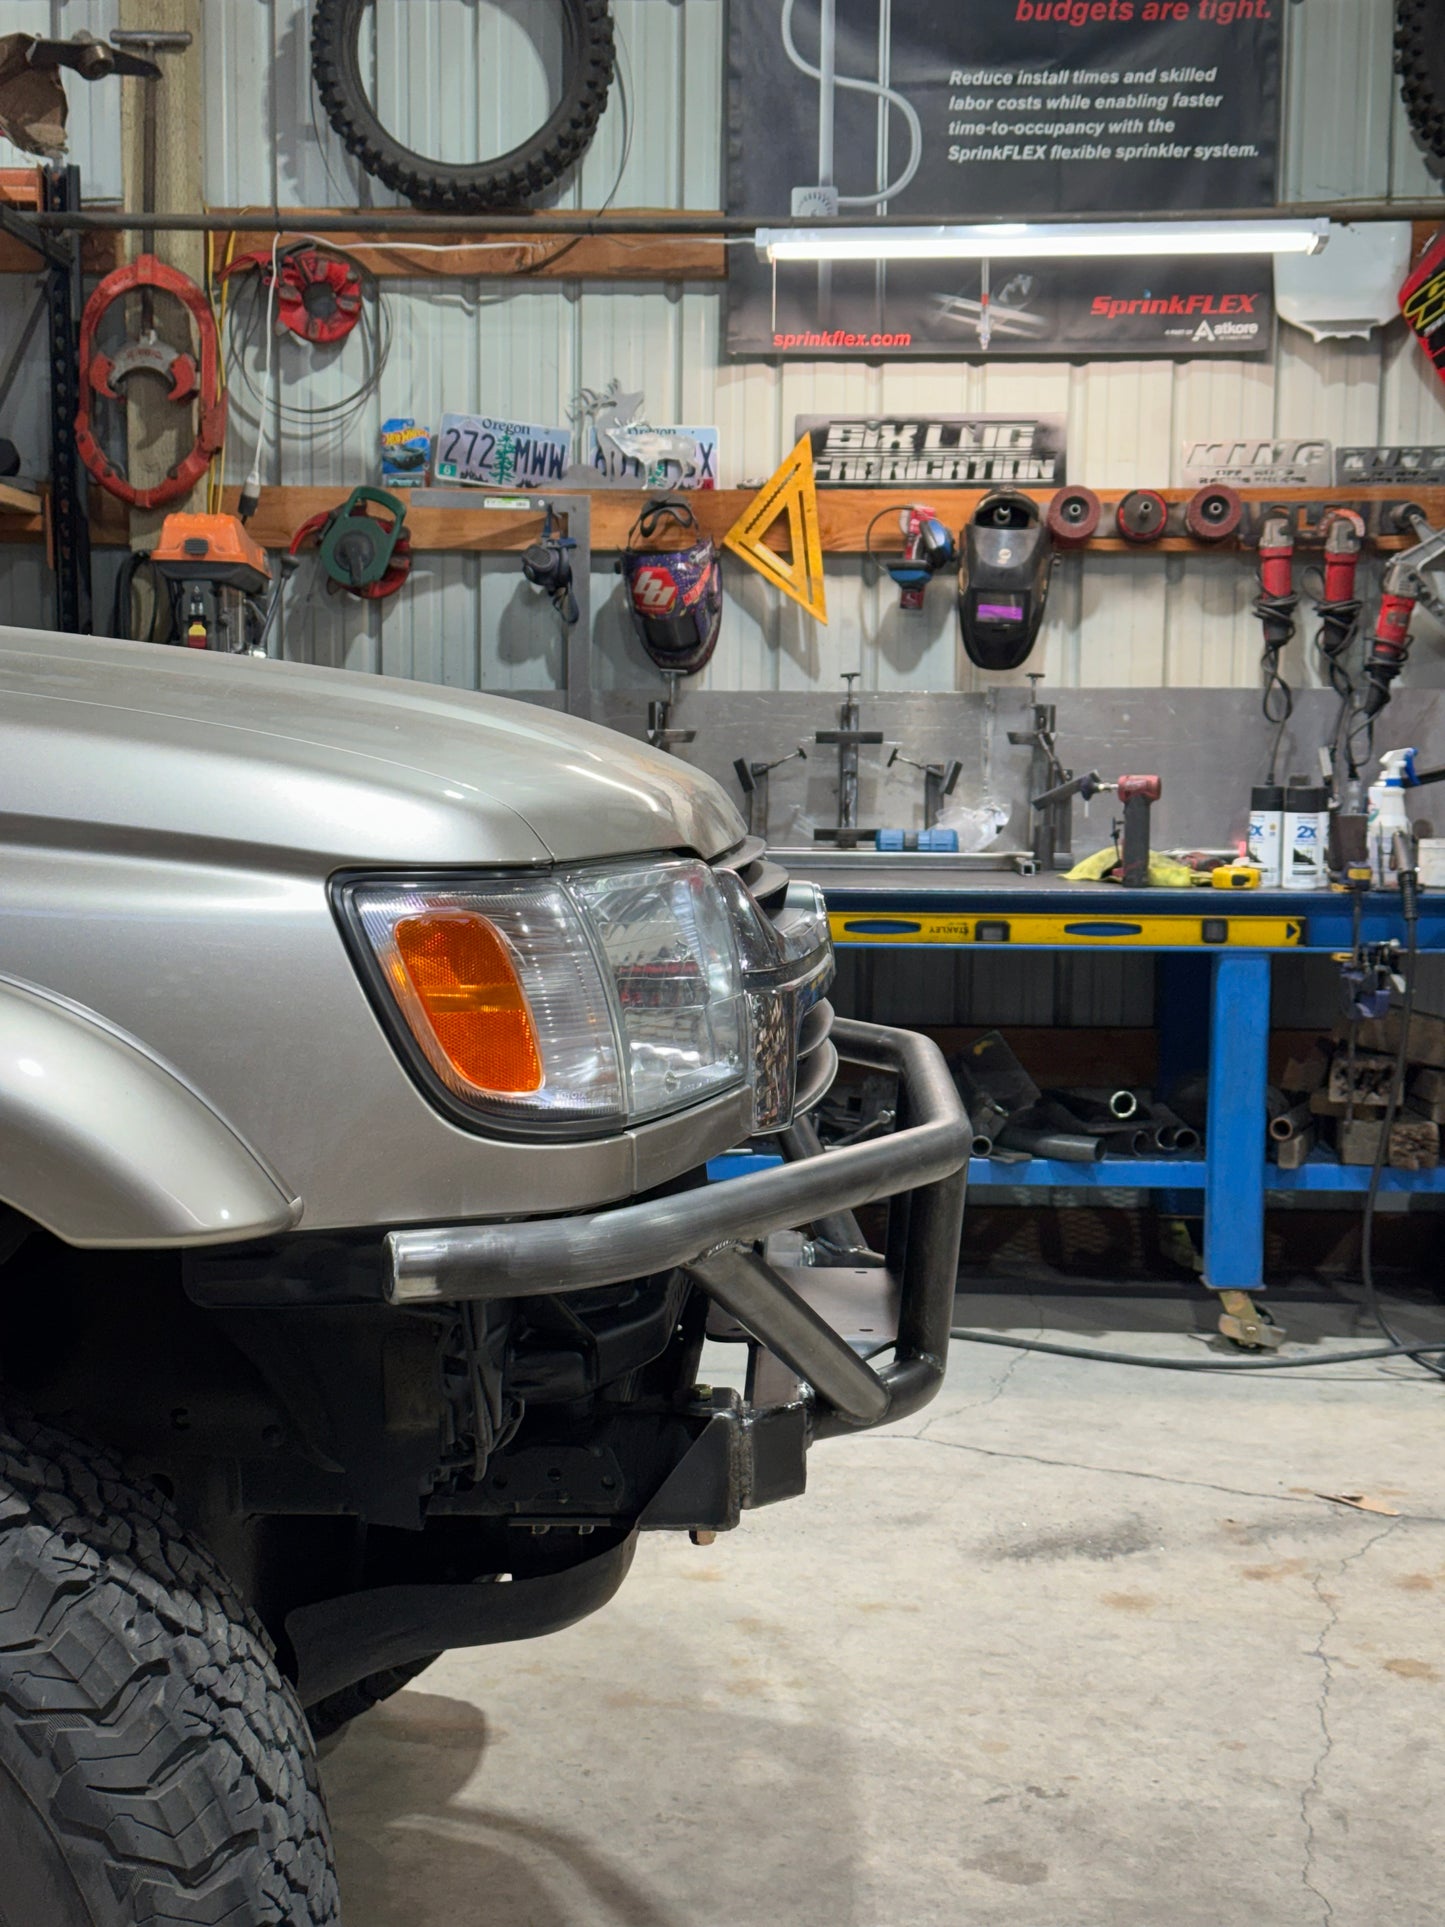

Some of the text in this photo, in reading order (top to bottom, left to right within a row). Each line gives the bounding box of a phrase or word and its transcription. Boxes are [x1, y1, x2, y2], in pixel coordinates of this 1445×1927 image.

[1015, 0, 1272, 27] budgets are tight.
[949, 66, 1218, 86] Reduce install times and skilled
[949, 91, 1223, 111] labor costs while enabling faster
[948, 117, 1176, 138] time-to-occupancy with the
[948, 142, 1259, 163] SprinkFLEX flexible sprinkler system.
[1090, 293, 1259, 319] SprinkFLEX
[1213, 322, 1259, 335] atkore
[773, 330, 912, 350] sprinkflex.com
[481, 417, 531, 436] Oregon
[443, 427, 496, 469] 272
[513, 437, 566, 481] MWW
[1296, 825, 1317, 839] 2X
